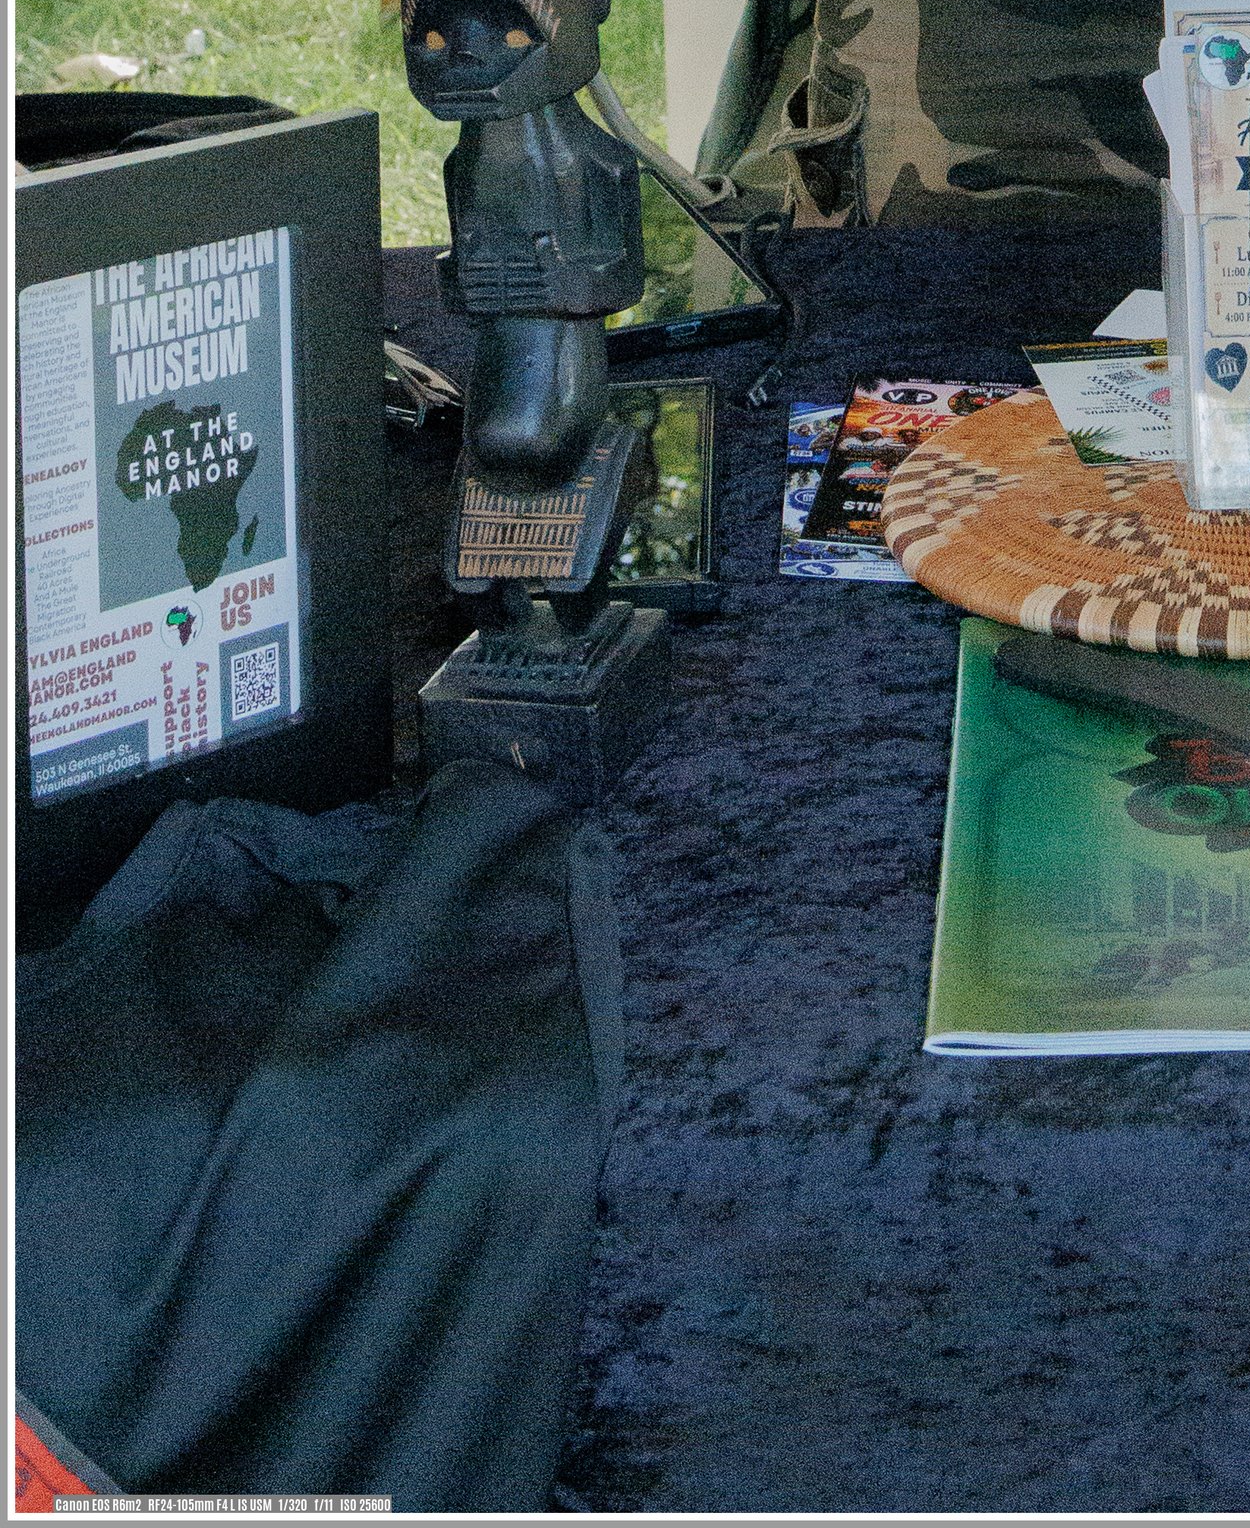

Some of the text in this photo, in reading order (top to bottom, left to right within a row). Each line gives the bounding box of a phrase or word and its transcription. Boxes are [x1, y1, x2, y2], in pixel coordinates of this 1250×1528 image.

[155, 229, 274, 291] AFRICAN
[1222, 267, 1246, 277] 11:00
[110, 271, 260, 354] AMERICAN
[1225, 312, 1245, 322] 4:00
[116, 325, 248, 405] MUSEUM
[144, 412, 238, 455] AT THE
[866, 411, 957, 428] ONE
[22, 458, 87, 486] ENEALOGY
[129, 432, 253, 482] ENGLAND
[145, 458, 238, 500] MANOR
[220, 573, 275, 610] JOIN
[221, 604, 252, 632] US
[80, 621, 154, 655] ENGLAND
[35, 766, 56, 783] 503
[59, 763, 67, 775] N
[68, 748, 116, 772] Genesee
[107, 752, 141, 774] 60085
